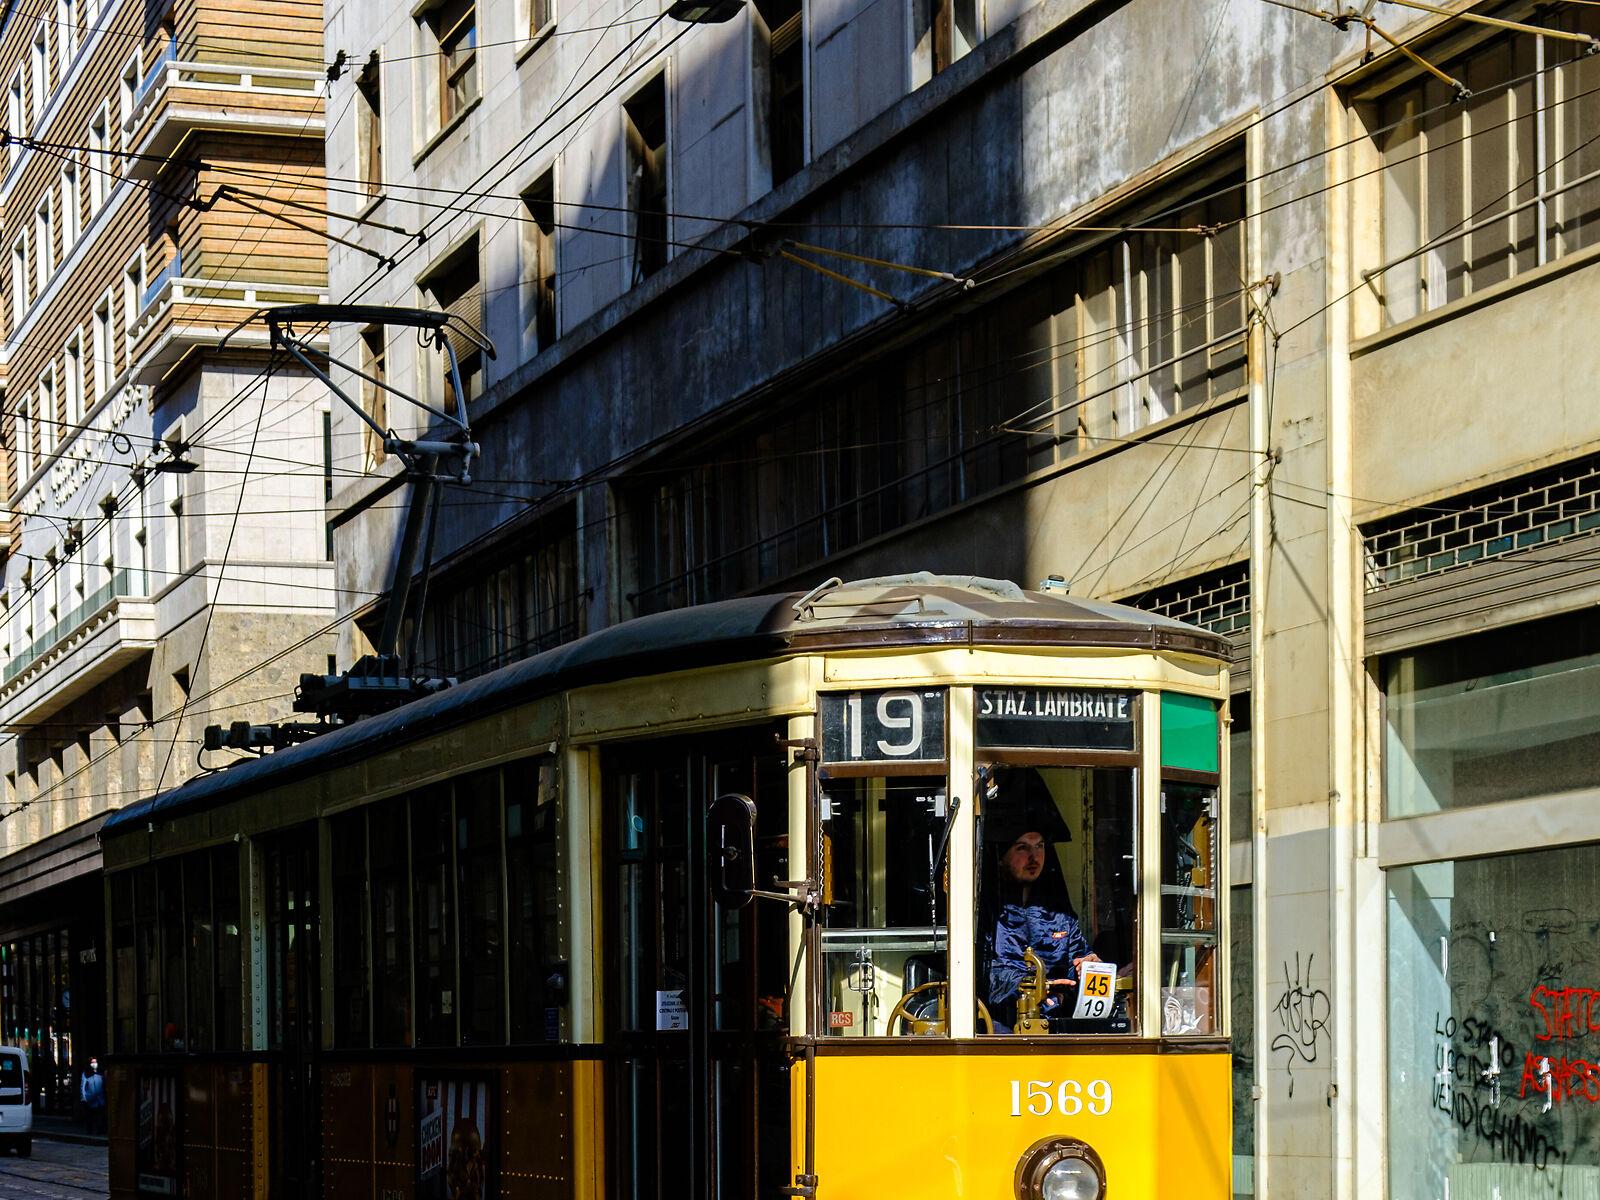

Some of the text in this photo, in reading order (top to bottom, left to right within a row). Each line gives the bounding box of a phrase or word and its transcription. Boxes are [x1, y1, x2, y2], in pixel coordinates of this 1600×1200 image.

[981, 690, 1128, 719] STAZ. LAMBRATE
[845, 689, 923, 758] 19
[1086, 975, 1109, 996] 45
[832, 1013, 851, 1024] RCS
[1084, 999, 1105, 1017] 19
[1435, 1012, 1457, 1038] LO
[1010, 1079, 1113, 1117] 1569
